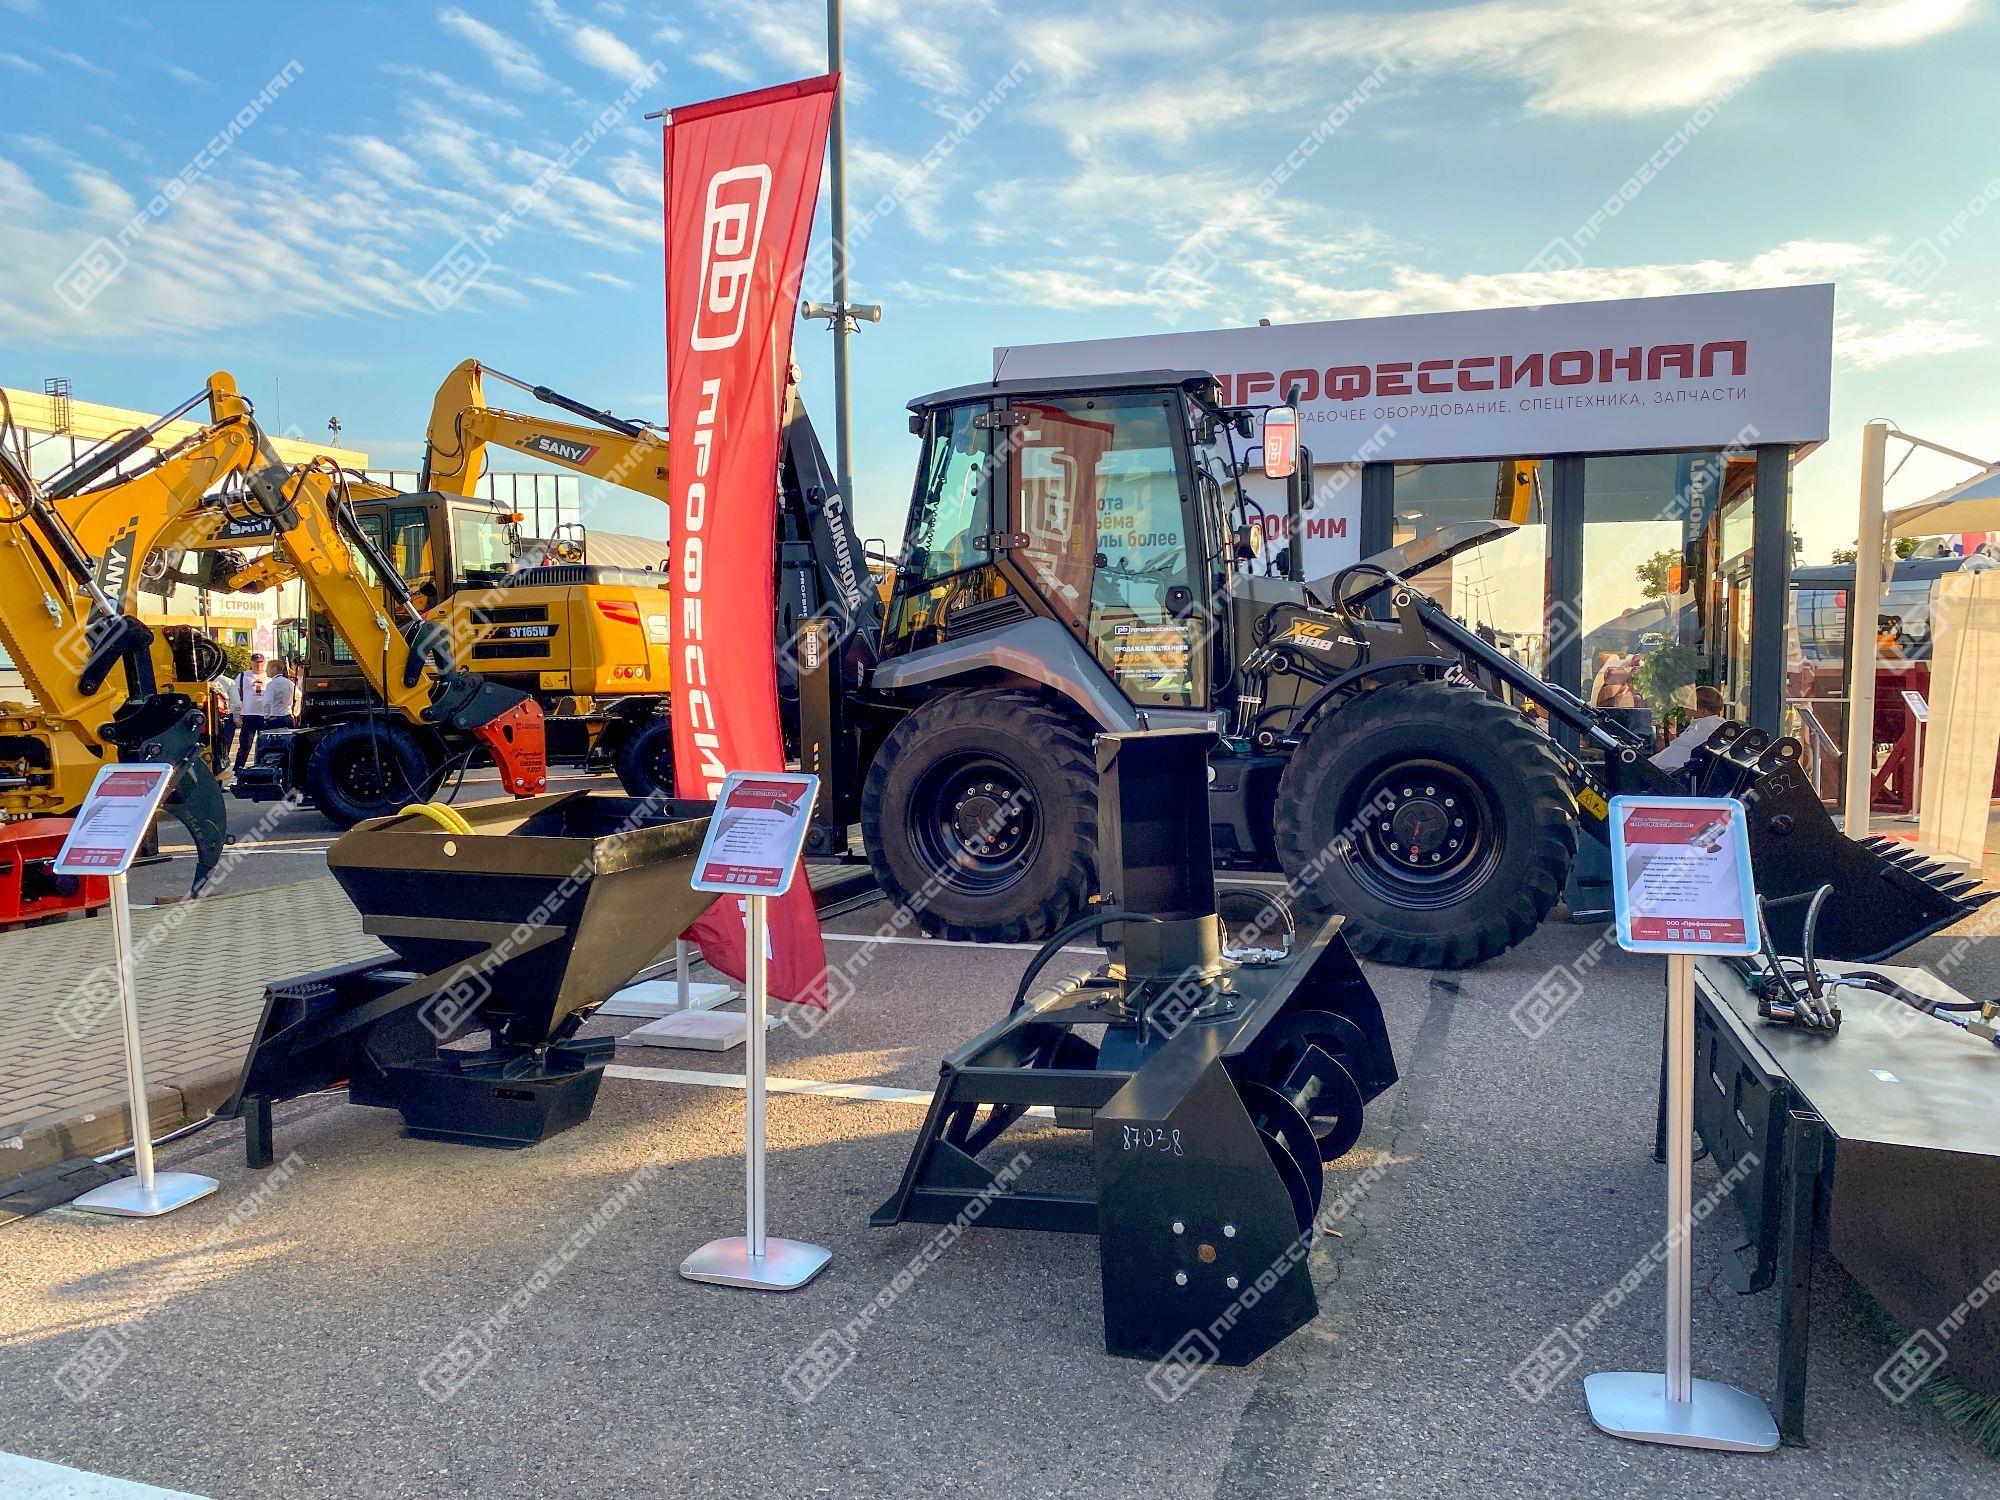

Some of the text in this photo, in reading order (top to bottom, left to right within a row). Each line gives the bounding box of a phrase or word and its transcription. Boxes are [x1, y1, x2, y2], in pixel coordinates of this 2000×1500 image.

[1299, 387, 1748, 425] РАБОЧЕЕ ОБОРУДОВАНИЕ, СПЕЦТЕХНИКА, ЗАПЧАСТИ
[538, 438, 582, 462] SANY
[1127, 530, 1177, 548] более
[824, 493, 862, 611] ÇUKUROVA
[226, 600, 265, 611] СТРОИМ
[509, 626, 549, 638] SY165W
[1282, 621, 1330, 638] XG
[1293, 634, 1334, 651] 888
[1122, 1126, 1185, 1157] 87038
